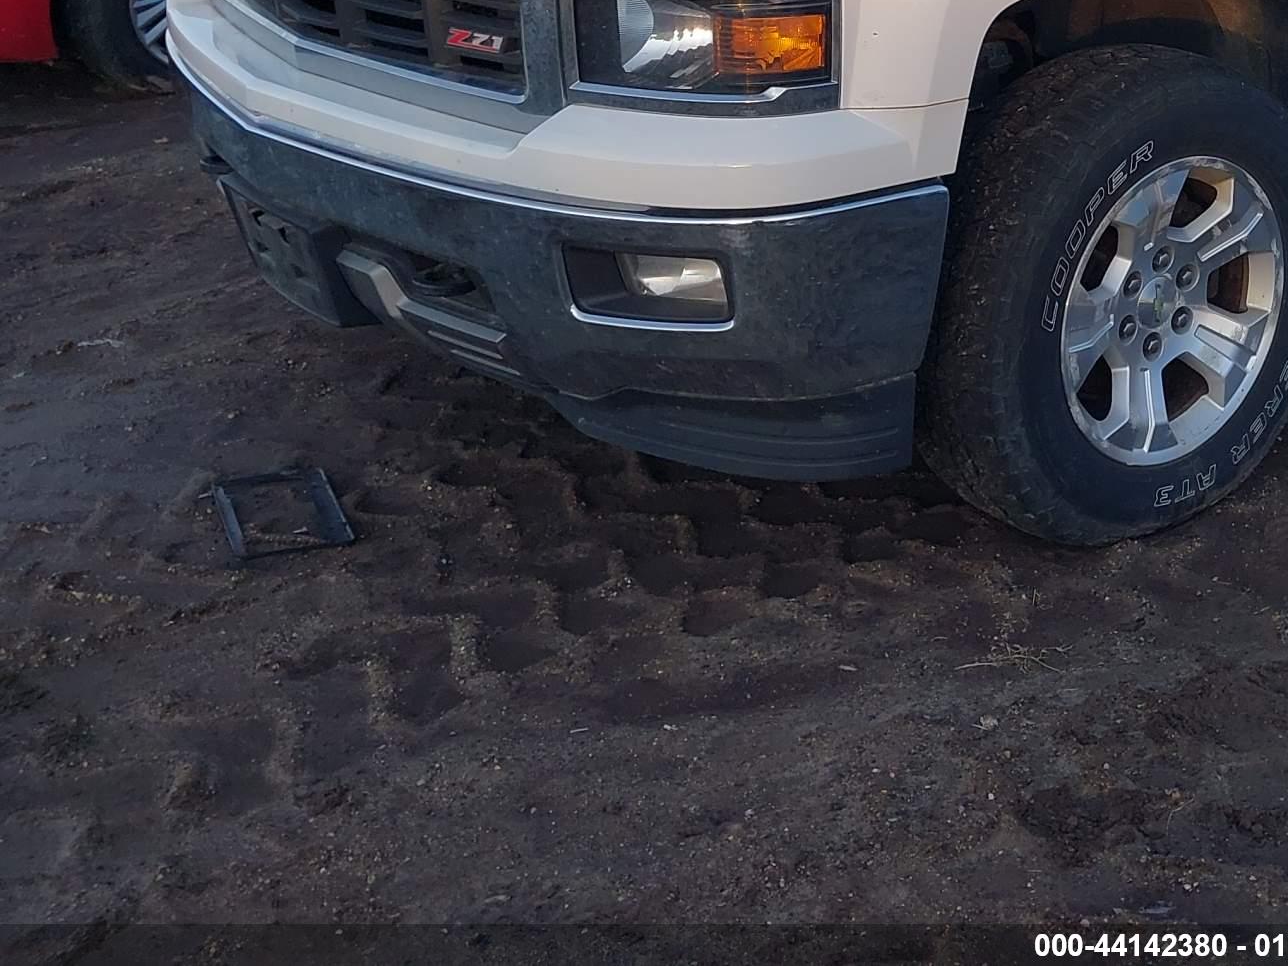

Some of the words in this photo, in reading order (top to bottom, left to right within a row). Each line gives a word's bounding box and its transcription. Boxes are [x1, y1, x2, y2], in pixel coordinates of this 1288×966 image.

[447, 28, 504, 53] Z71
[1041, 140, 1154, 332] COOPER
[1153, 463, 1217, 507] AT3
